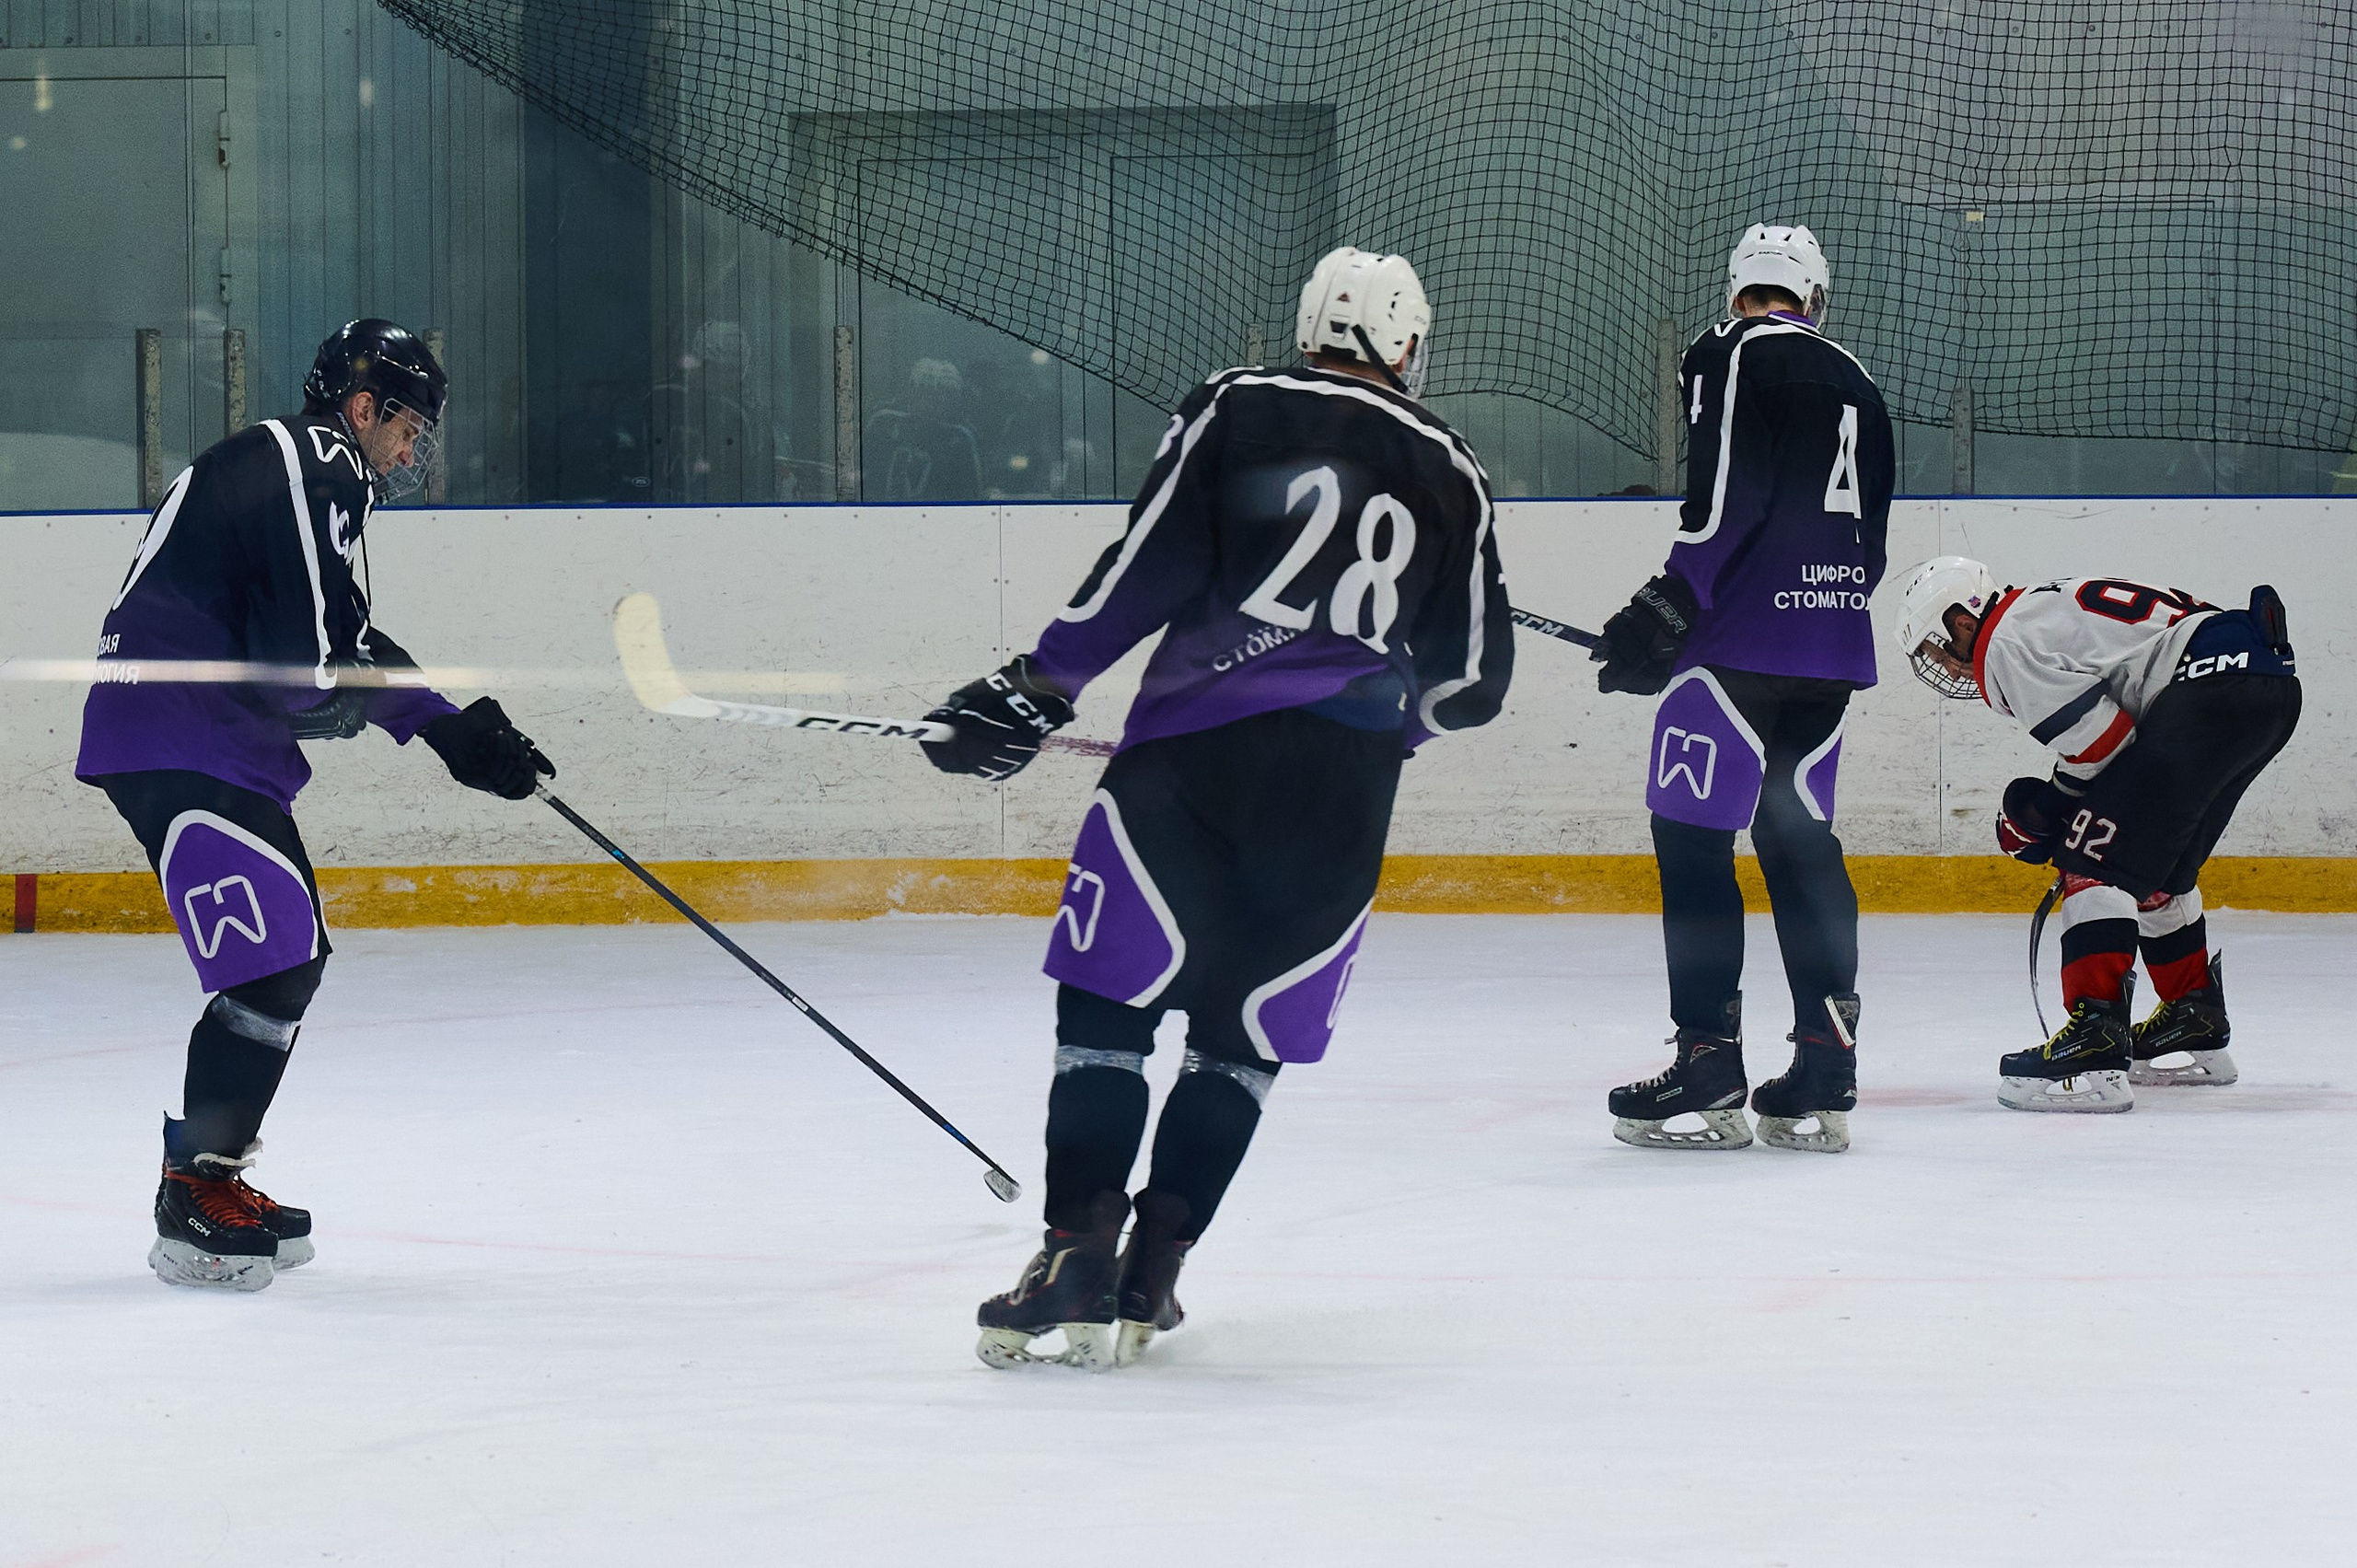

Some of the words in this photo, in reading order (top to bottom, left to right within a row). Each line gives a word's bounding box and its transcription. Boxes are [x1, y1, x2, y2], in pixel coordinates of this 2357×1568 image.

[1824, 403, 1862, 521] 4
[1237, 465, 1416, 655] 28
[1802, 564, 1865, 586] ЦИФРО
[1213, 626, 1295, 672] СТОМ
[795, 716, 930, 739] CCM
[986, 672, 1054, 734] CCM
[2065, 808, 2117, 861] 92
[188, 1217, 212, 1237] CCM
